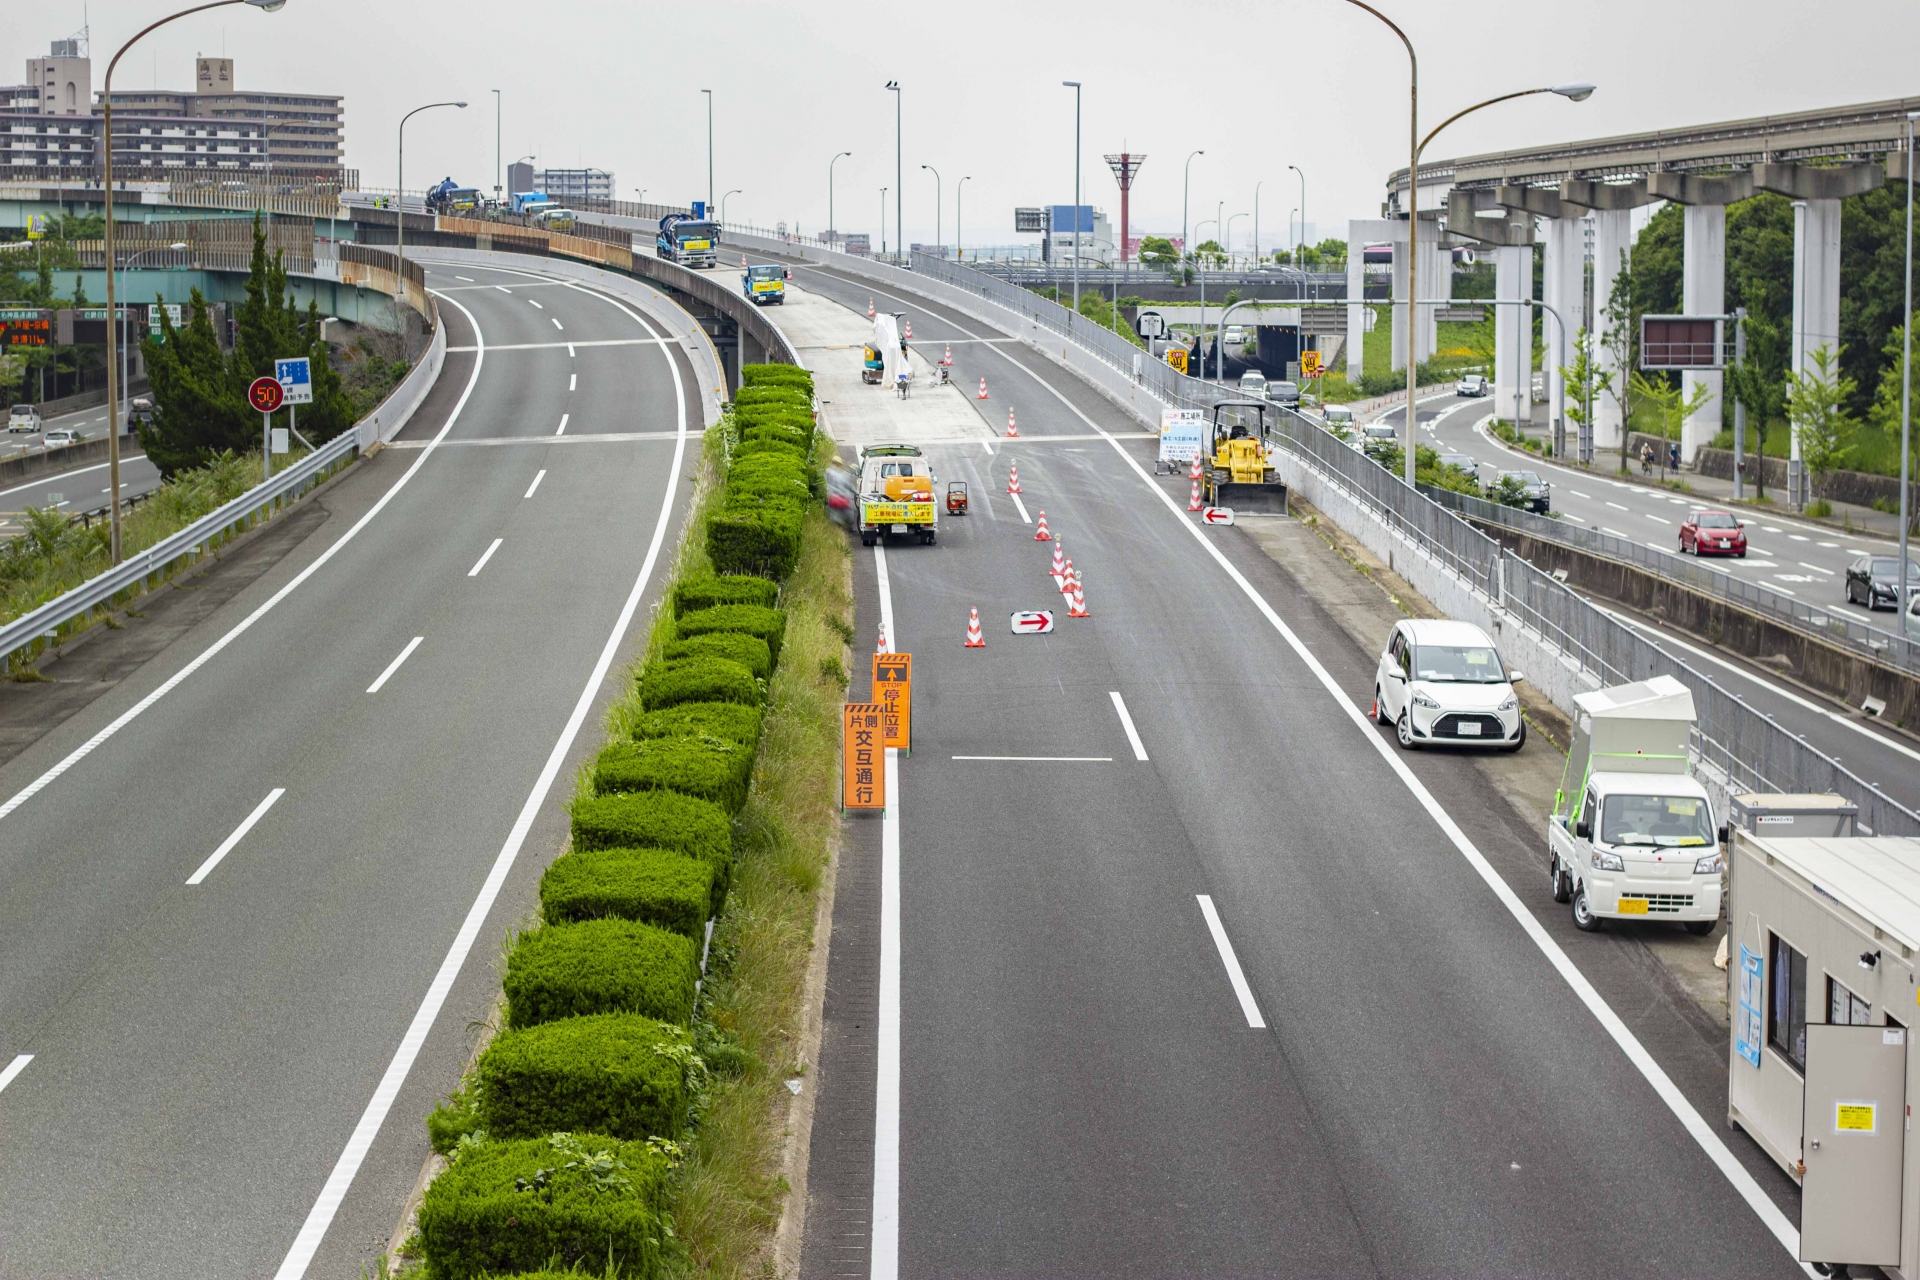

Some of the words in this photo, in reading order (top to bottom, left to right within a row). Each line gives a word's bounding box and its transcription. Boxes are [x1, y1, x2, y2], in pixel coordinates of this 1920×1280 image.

[84, 311, 122, 319] 近畿自動道
[257, 387, 275, 403] 50
[1180, 412, 1201, 420] 施工場所
[883, 689, 900, 739] 停止位置
[850, 715, 878, 728] 片側
[855, 730, 874, 804] 交互通行
